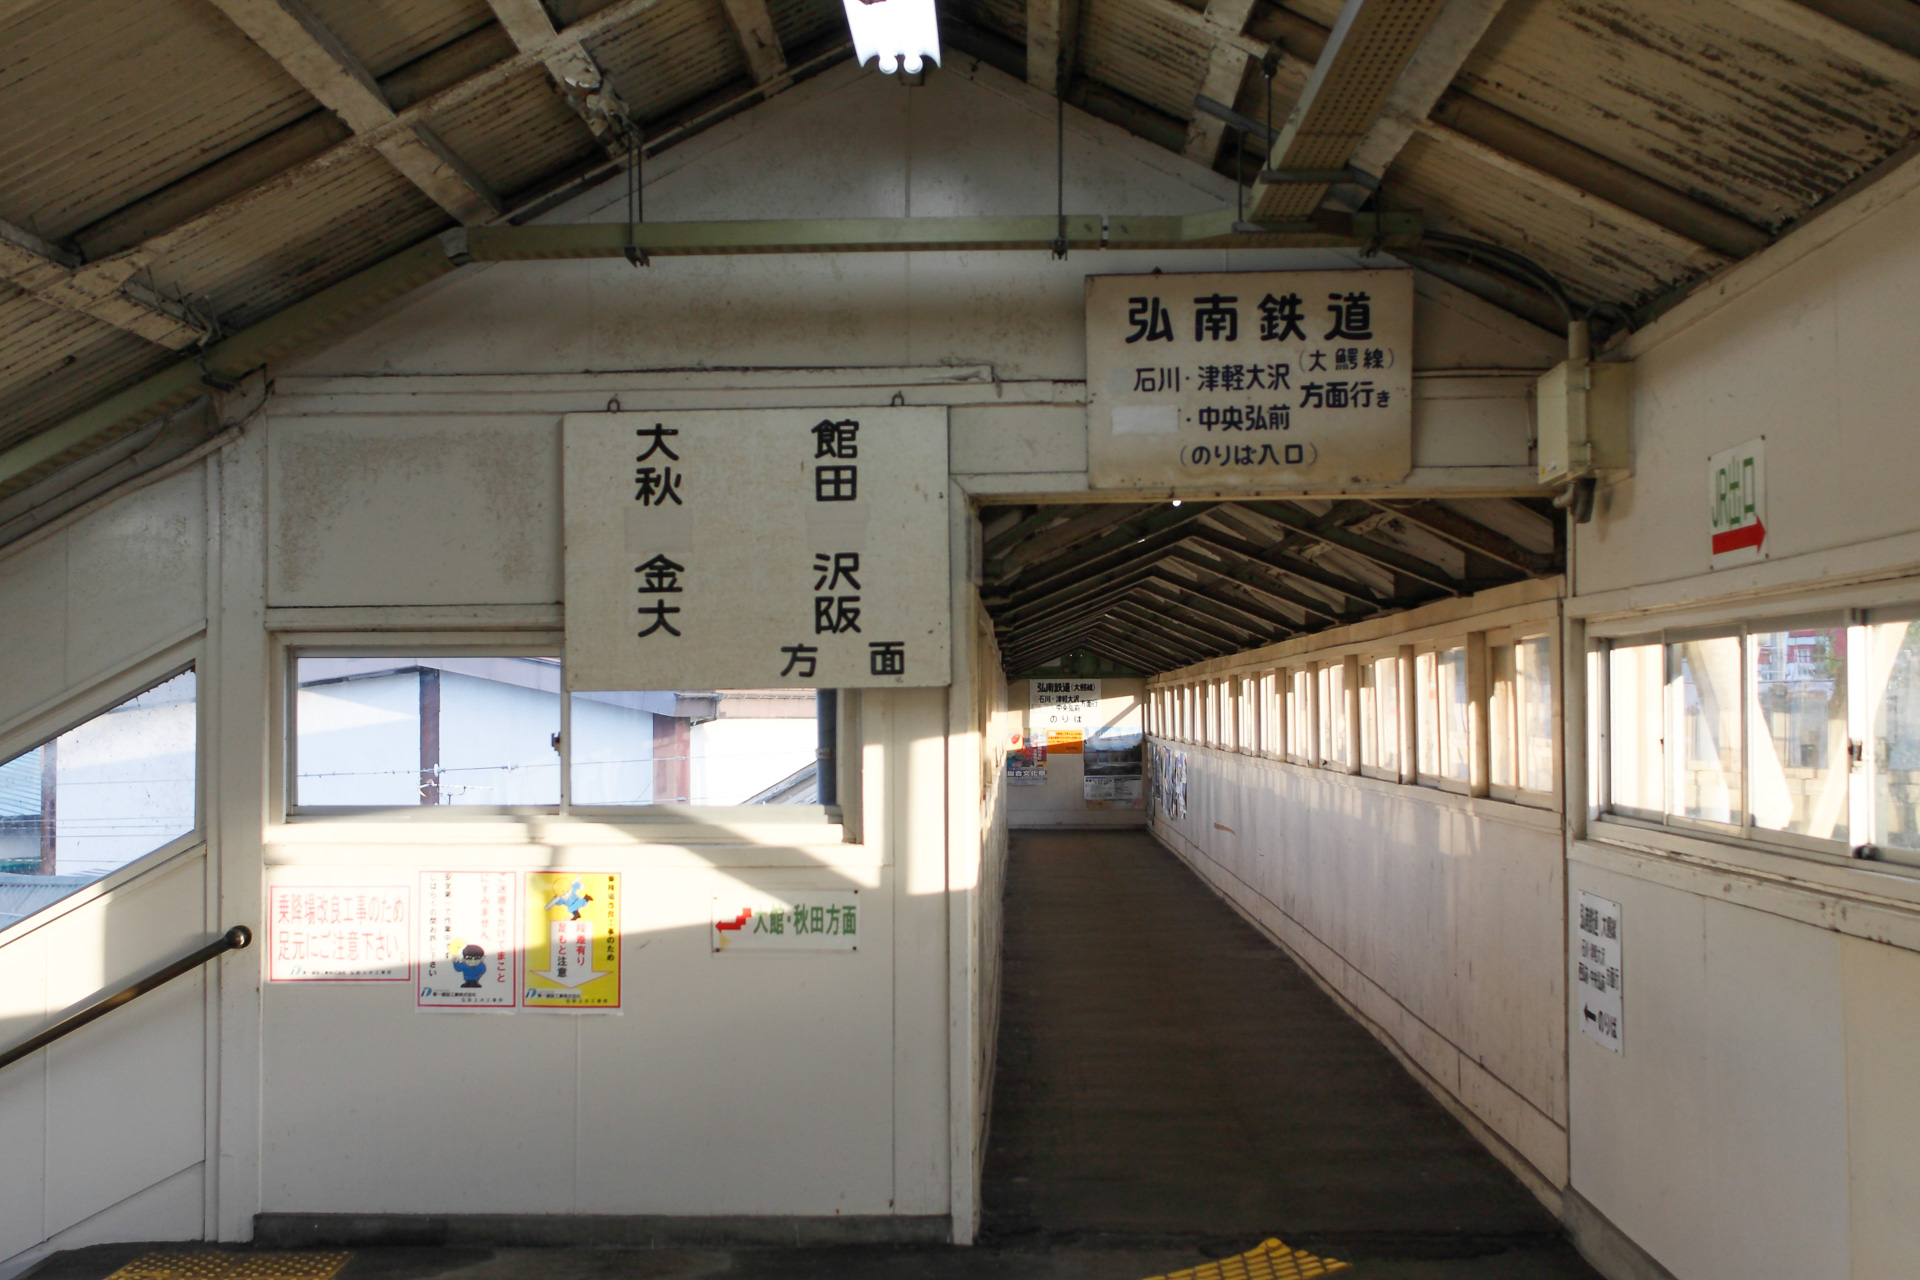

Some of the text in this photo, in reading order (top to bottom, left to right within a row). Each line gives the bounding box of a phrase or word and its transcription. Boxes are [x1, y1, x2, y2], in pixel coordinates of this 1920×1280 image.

[1125, 292, 1373, 343] 弘南鉄道
[1299, 348, 1395, 374] （大鰐線）
[1133, 363, 1291, 393] 石川・津軽大沢
[1298, 381, 1391, 408] 方面行き
[1179, 442, 1318, 467] （のりば入口）
[1049, 715, 1082, 723] のりば
[277, 892, 405, 925] 乗降場改良工事のため
[753, 903, 857, 935] 大館・秋田方面
[277, 929, 405, 962] 足元にご注意下さい。
[556, 922, 568, 978] 足もと注意
[575, 922, 587, 967] 段差有り
